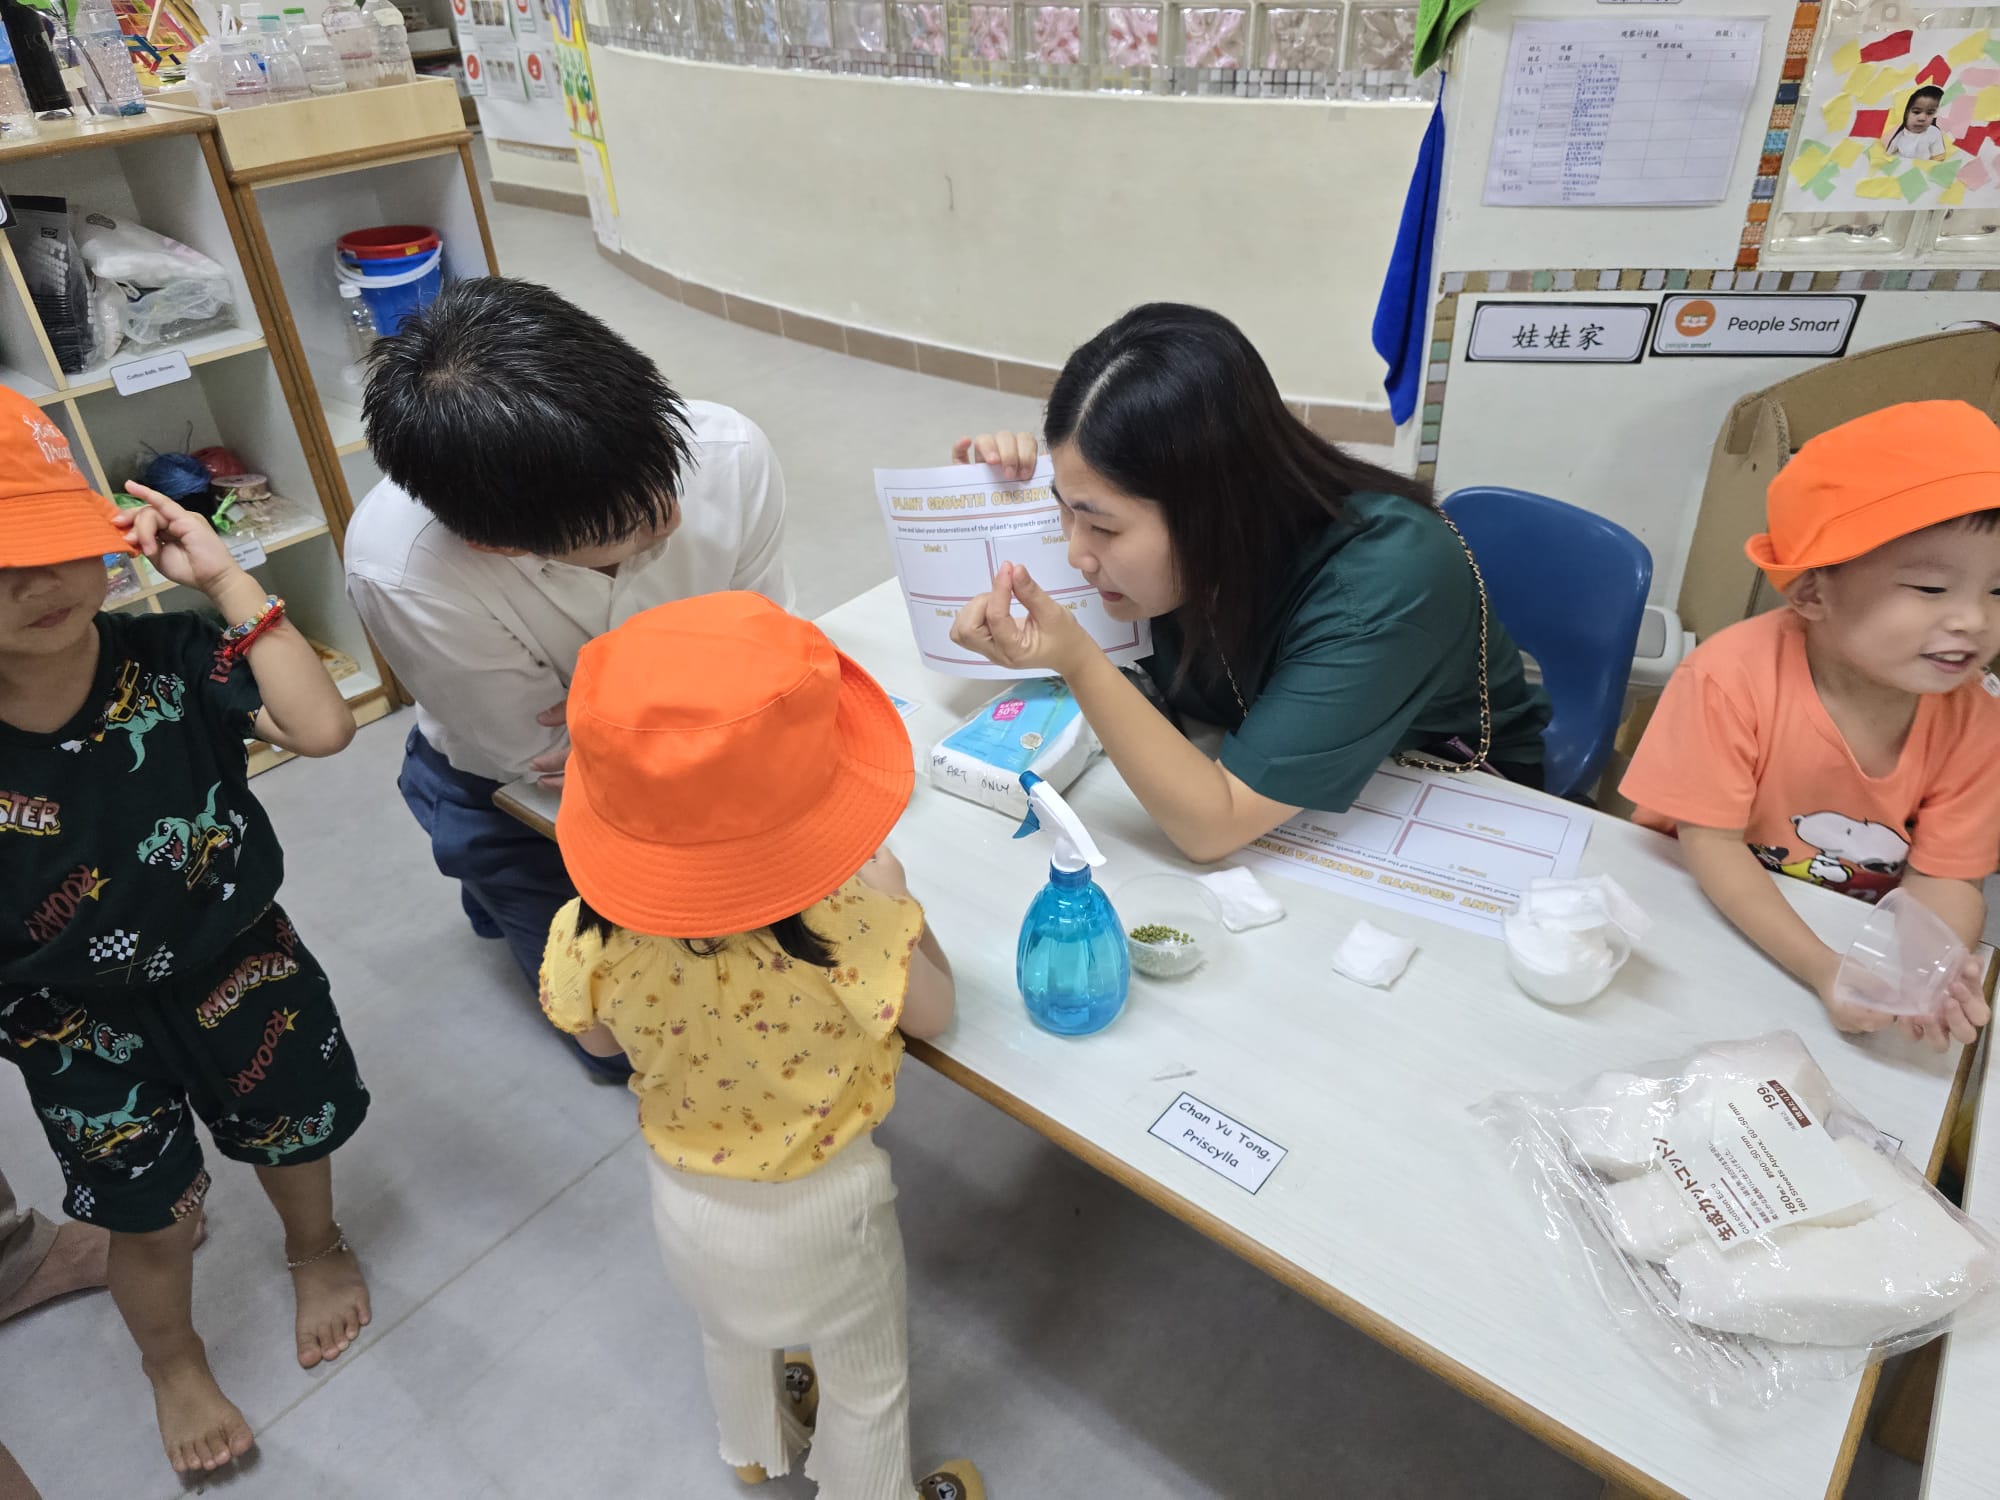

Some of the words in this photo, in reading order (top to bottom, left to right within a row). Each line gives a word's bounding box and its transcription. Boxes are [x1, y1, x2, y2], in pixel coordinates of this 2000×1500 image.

[1512, 323, 1605, 352] 娃娃家
[1727, 316, 1784, 335] People
[1788, 317, 1840, 333] Smart
[892, 496, 923, 511] PLANT
[927, 492, 986, 510] GROWTH
[991, 486, 1054, 506] OBSERV
[989, 523, 1012, 533] plant's
[1013, 519, 1036, 530] growth
[946, 765, 967, 784] ART
[981, 780, 1009, 795] ONLY
[1459, 897, 1508, 914] LANT
[201, 951, 298, 1026] MONSTER
[1178, 1102, 1211, 1124] Chan
[1216, 1120, 1233, 1137] Yu
[1182, 1128, 1240, 1168] Priscylla
[1758, 1138, 1779, 1169] Approx.
[1653, 1139, 1737, 1242] 生成カットコットン
[1709, 1182, 1724, 1199] Ecu
[1778, 1168, 1798, 1197] Sheets
[1720, 1198, 1741, 1222] cotton
[1736, 1221, 1750, 1234] Cut
